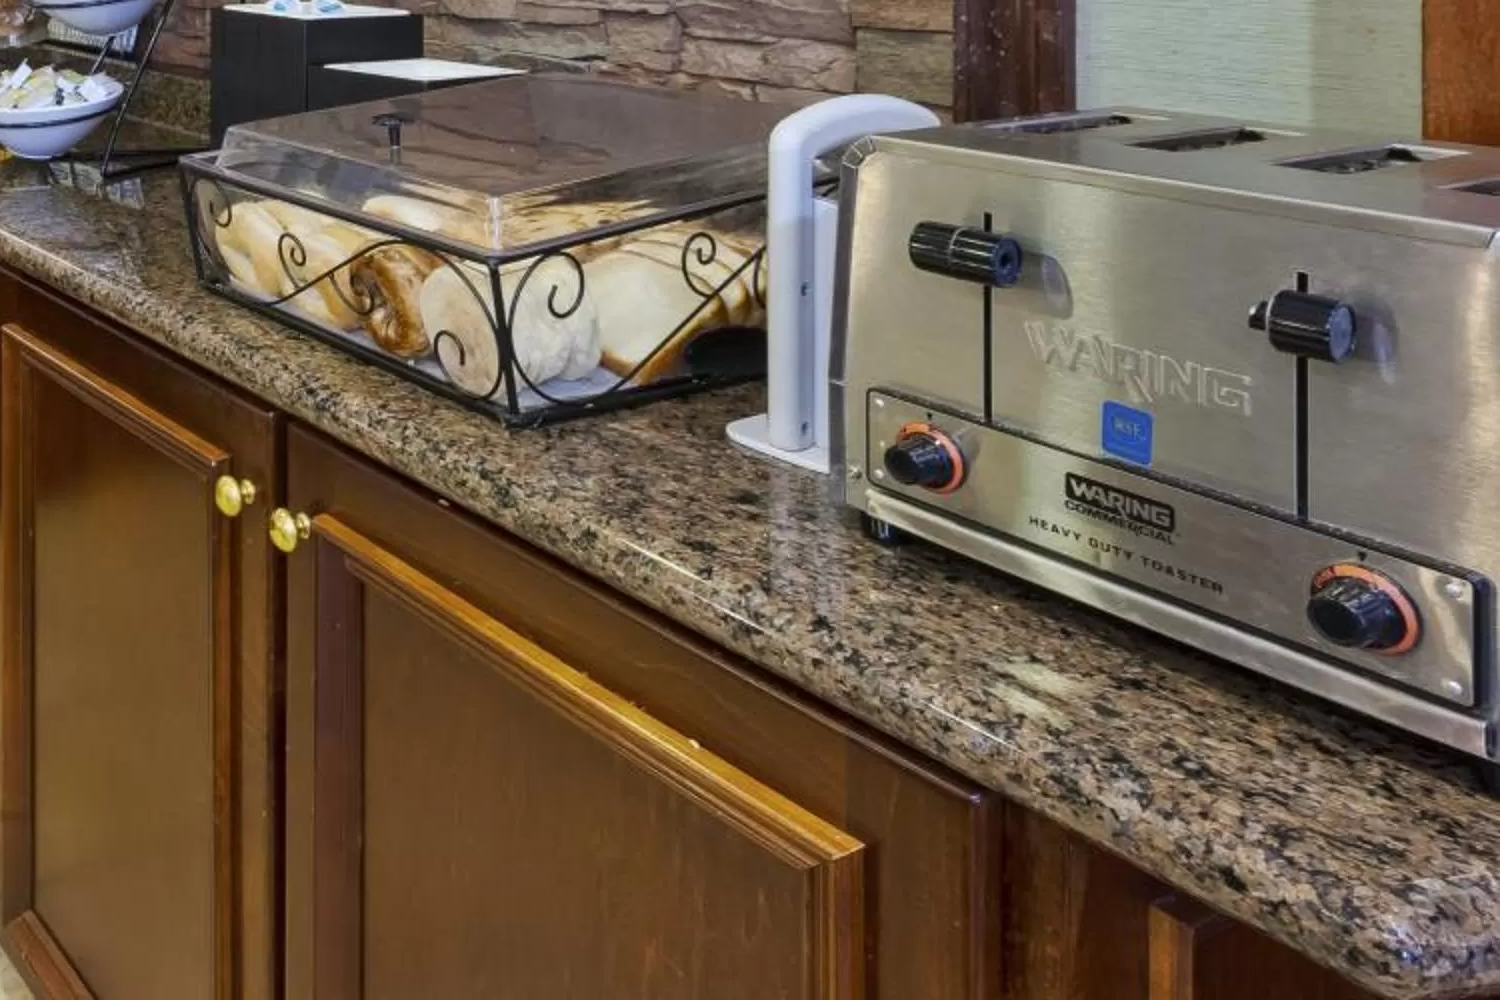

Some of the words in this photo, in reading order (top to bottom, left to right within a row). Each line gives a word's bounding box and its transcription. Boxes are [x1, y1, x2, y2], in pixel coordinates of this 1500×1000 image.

[1024, 319, 1253, 417] WARING
[1064, 499, 1174, 546] COMMERCIAL
[1068, 477, 1172, 529] WARING
[1029, 515, 1082, 541] HEAVY
[1088, 537, 1134, 561] DUTY
[1139, 555, 1224, 595] TOASTER
